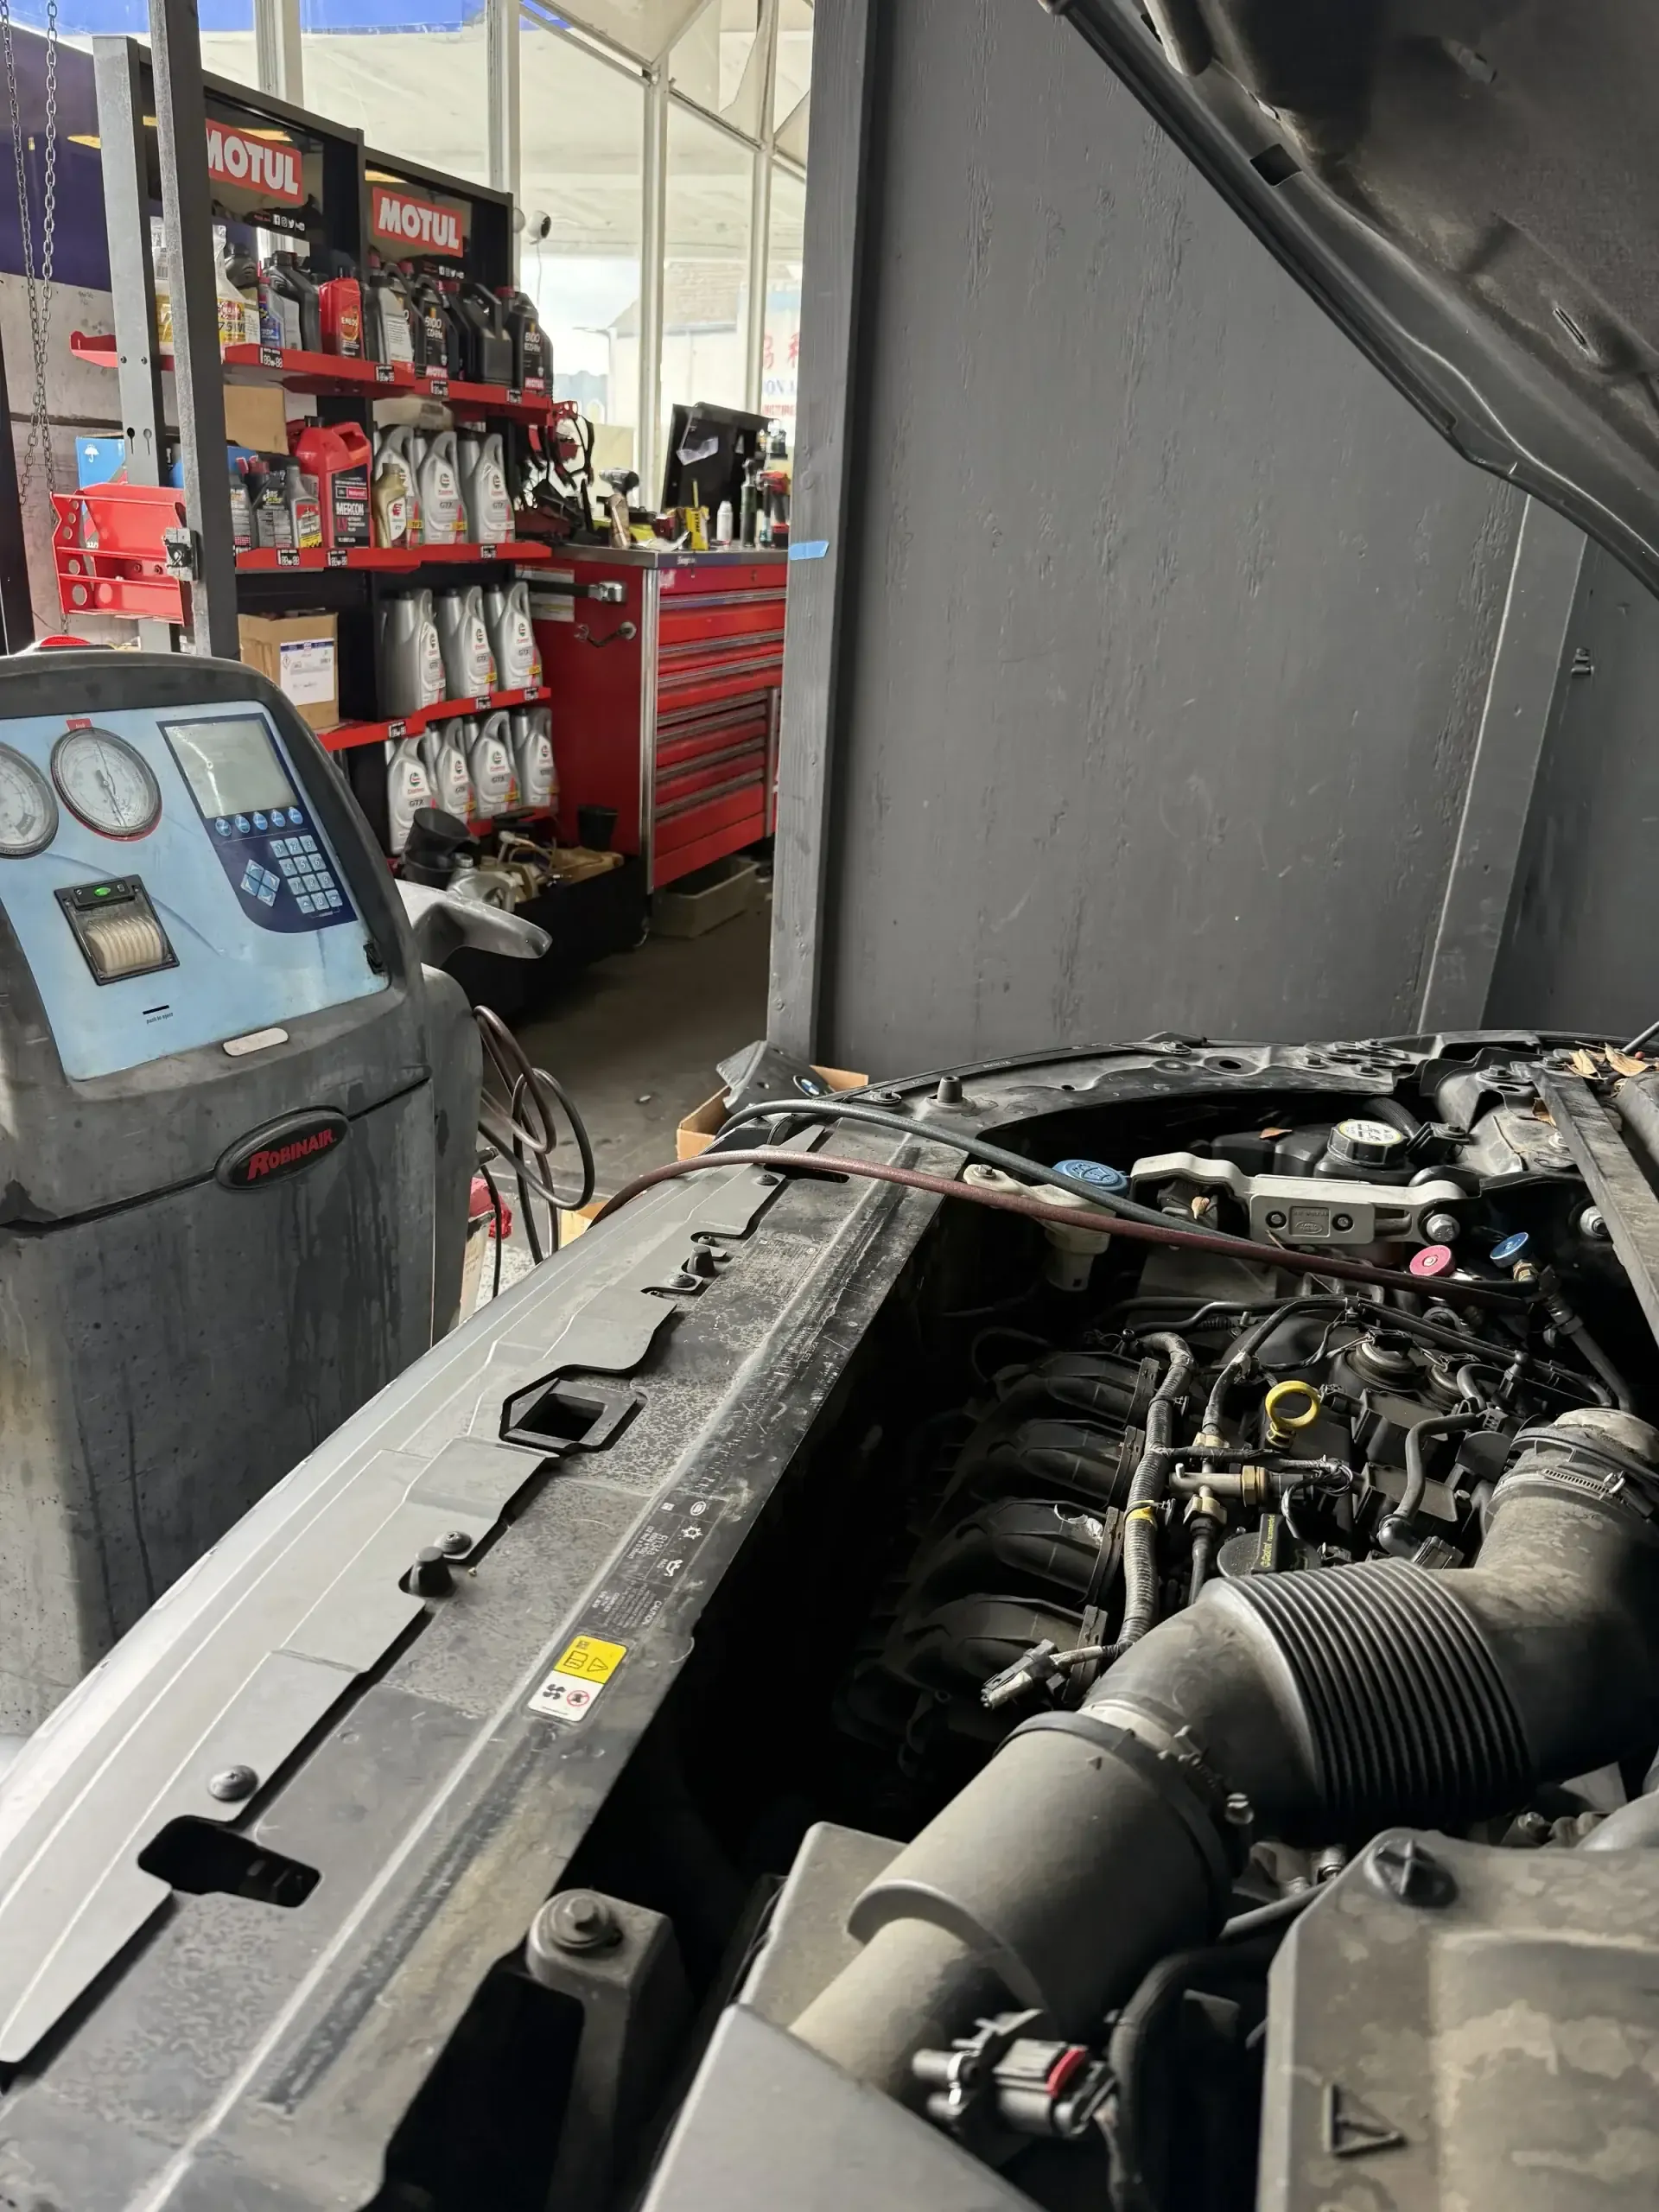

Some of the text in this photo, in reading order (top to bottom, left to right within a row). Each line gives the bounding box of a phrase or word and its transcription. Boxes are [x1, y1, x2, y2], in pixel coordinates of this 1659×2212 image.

[206, 128, 299, 195] MOTUL
[378, 196, 460, 250] MOTUL
[335, 502, 365, 516] MERCON
[246, 1128, 334, 1182] ROBINAIR
